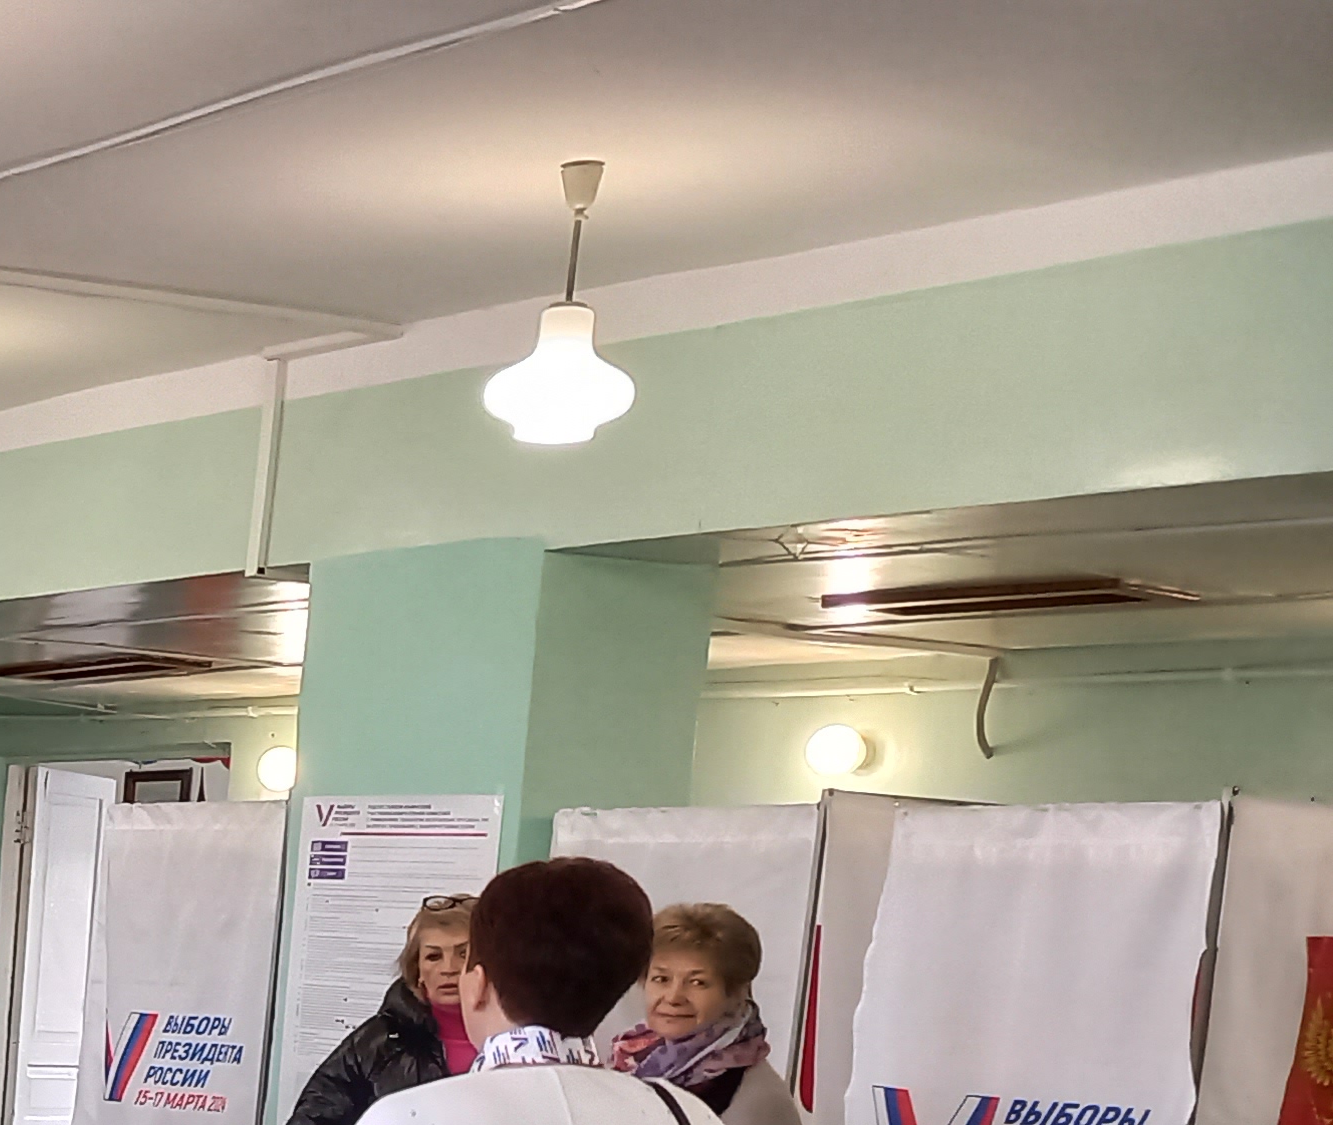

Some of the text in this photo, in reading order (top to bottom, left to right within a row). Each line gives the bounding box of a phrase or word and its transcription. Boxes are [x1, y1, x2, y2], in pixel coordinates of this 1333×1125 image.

[162, 1015, 232, 1036] ВЫБОРЫ
[143, 1065, 210, 1088] РОССИИ
[163, 1092, 208, 1111] МАРТА
